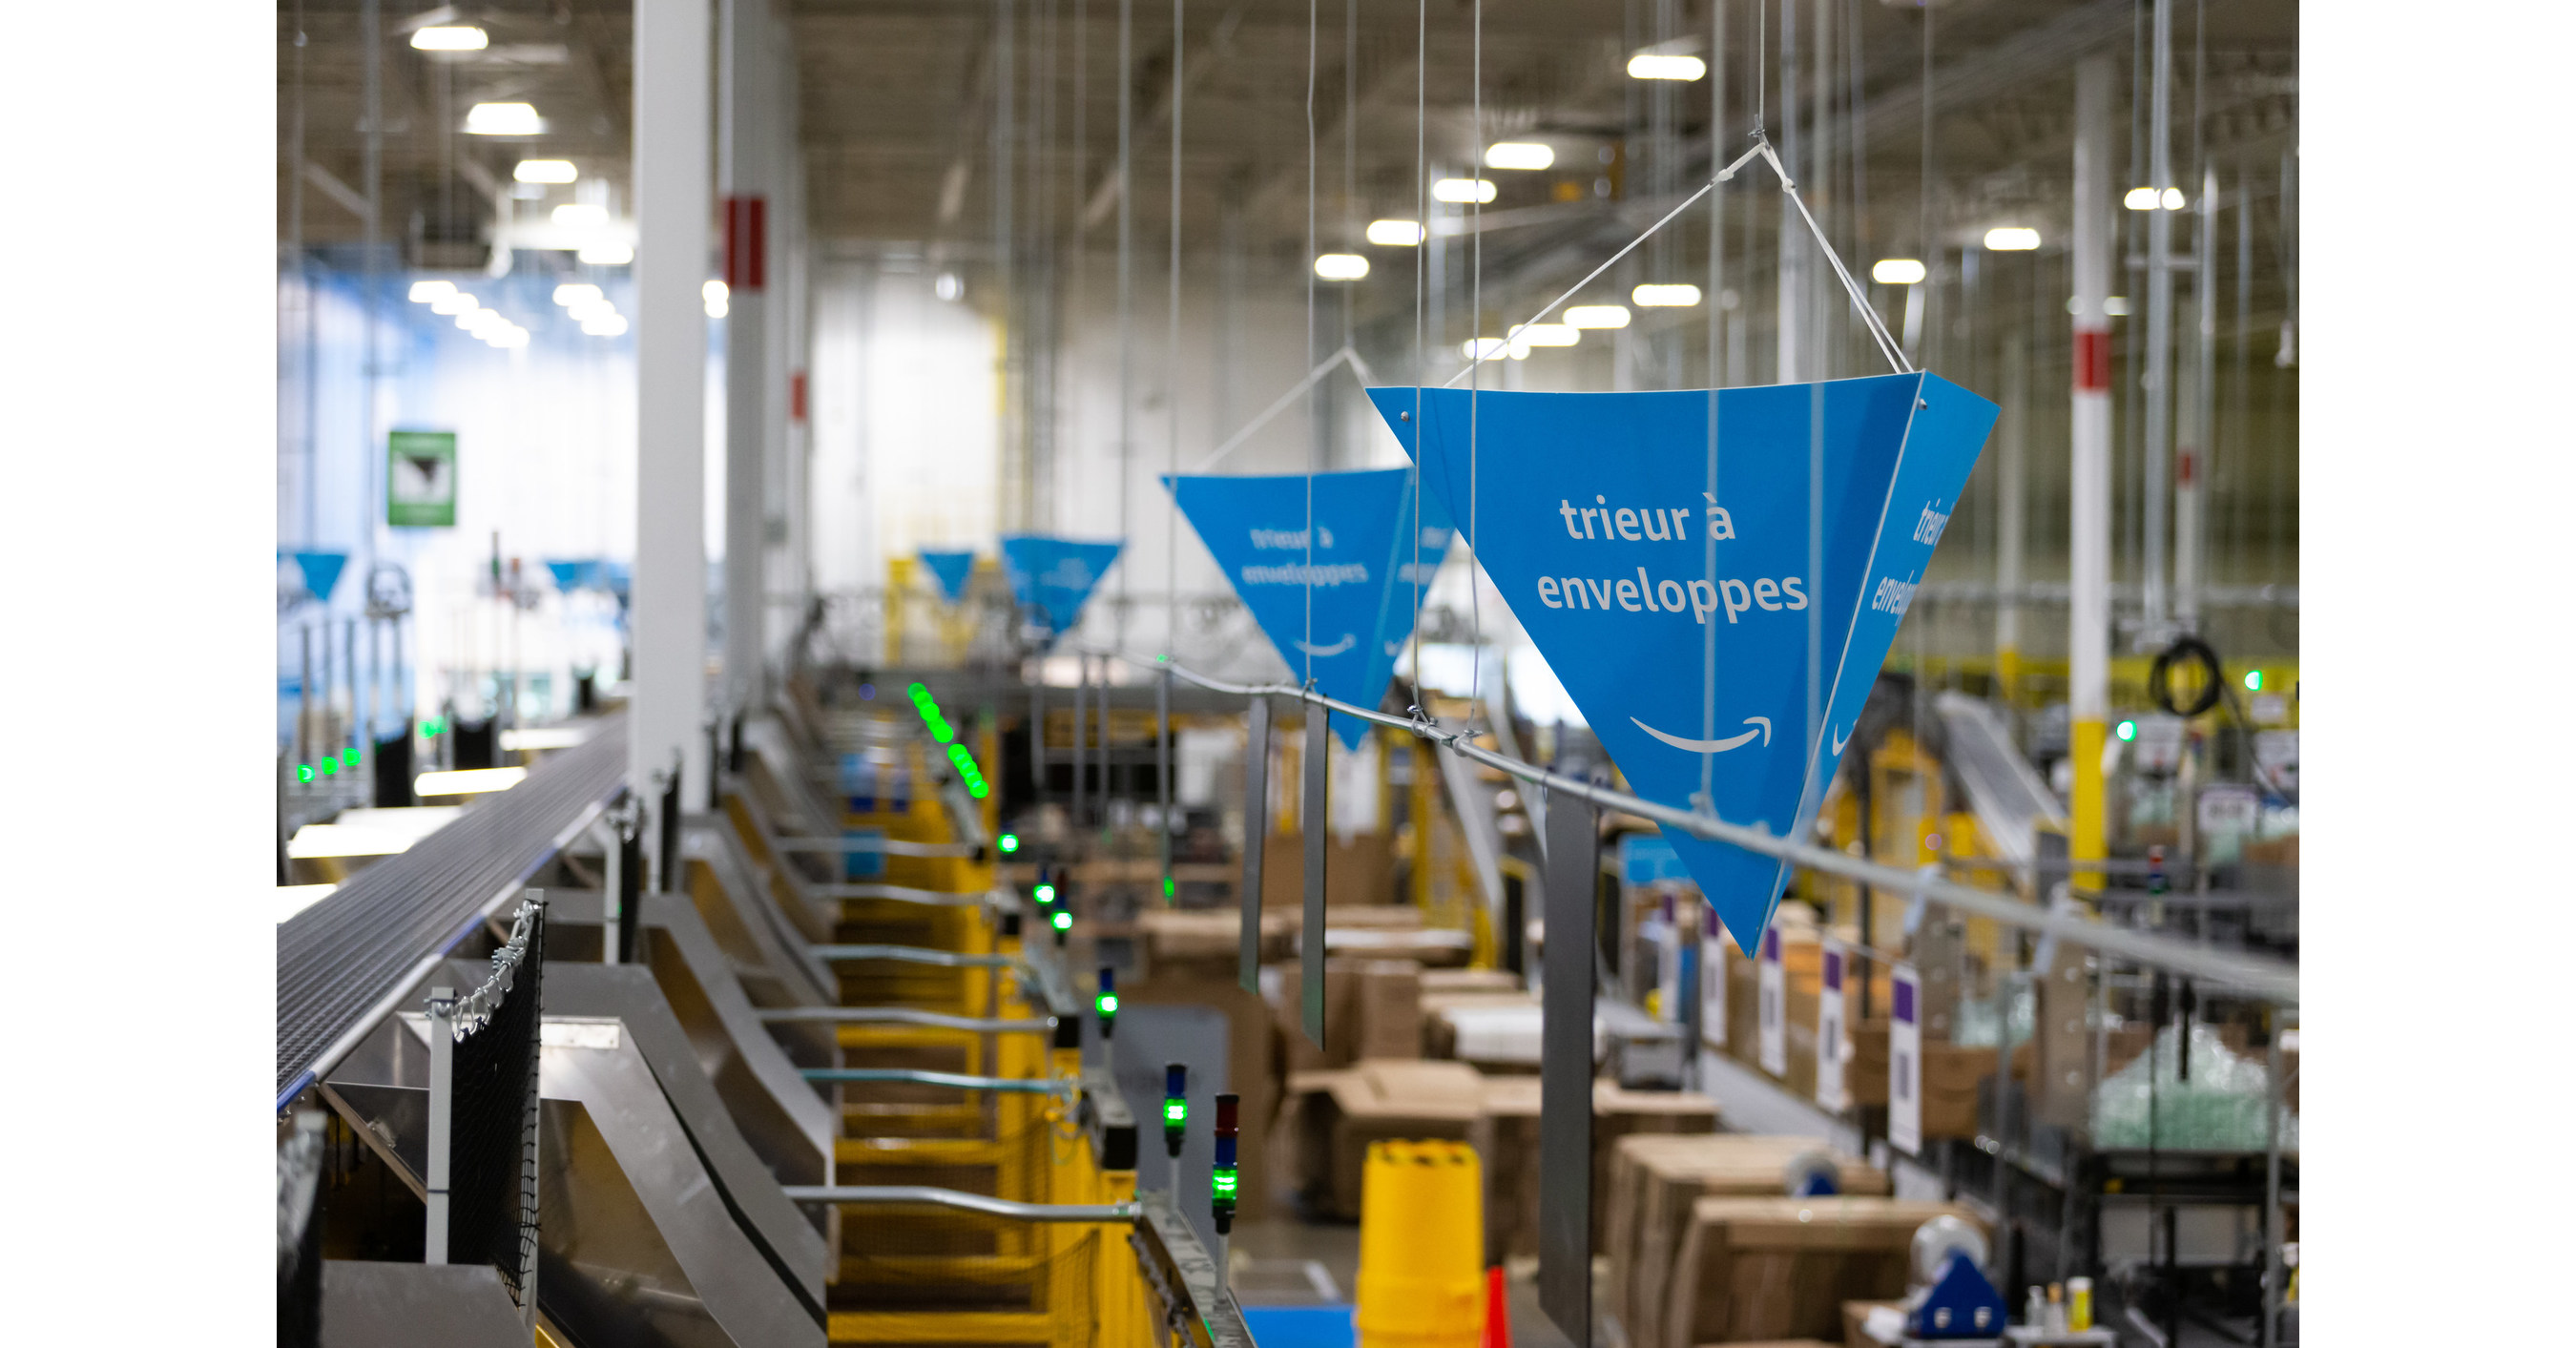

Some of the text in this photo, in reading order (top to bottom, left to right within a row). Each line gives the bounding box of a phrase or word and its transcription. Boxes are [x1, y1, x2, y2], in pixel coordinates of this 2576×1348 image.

[1559, 492, 1735, 541] trieur à
[1537, 567, 1809, 624] enveloppes
